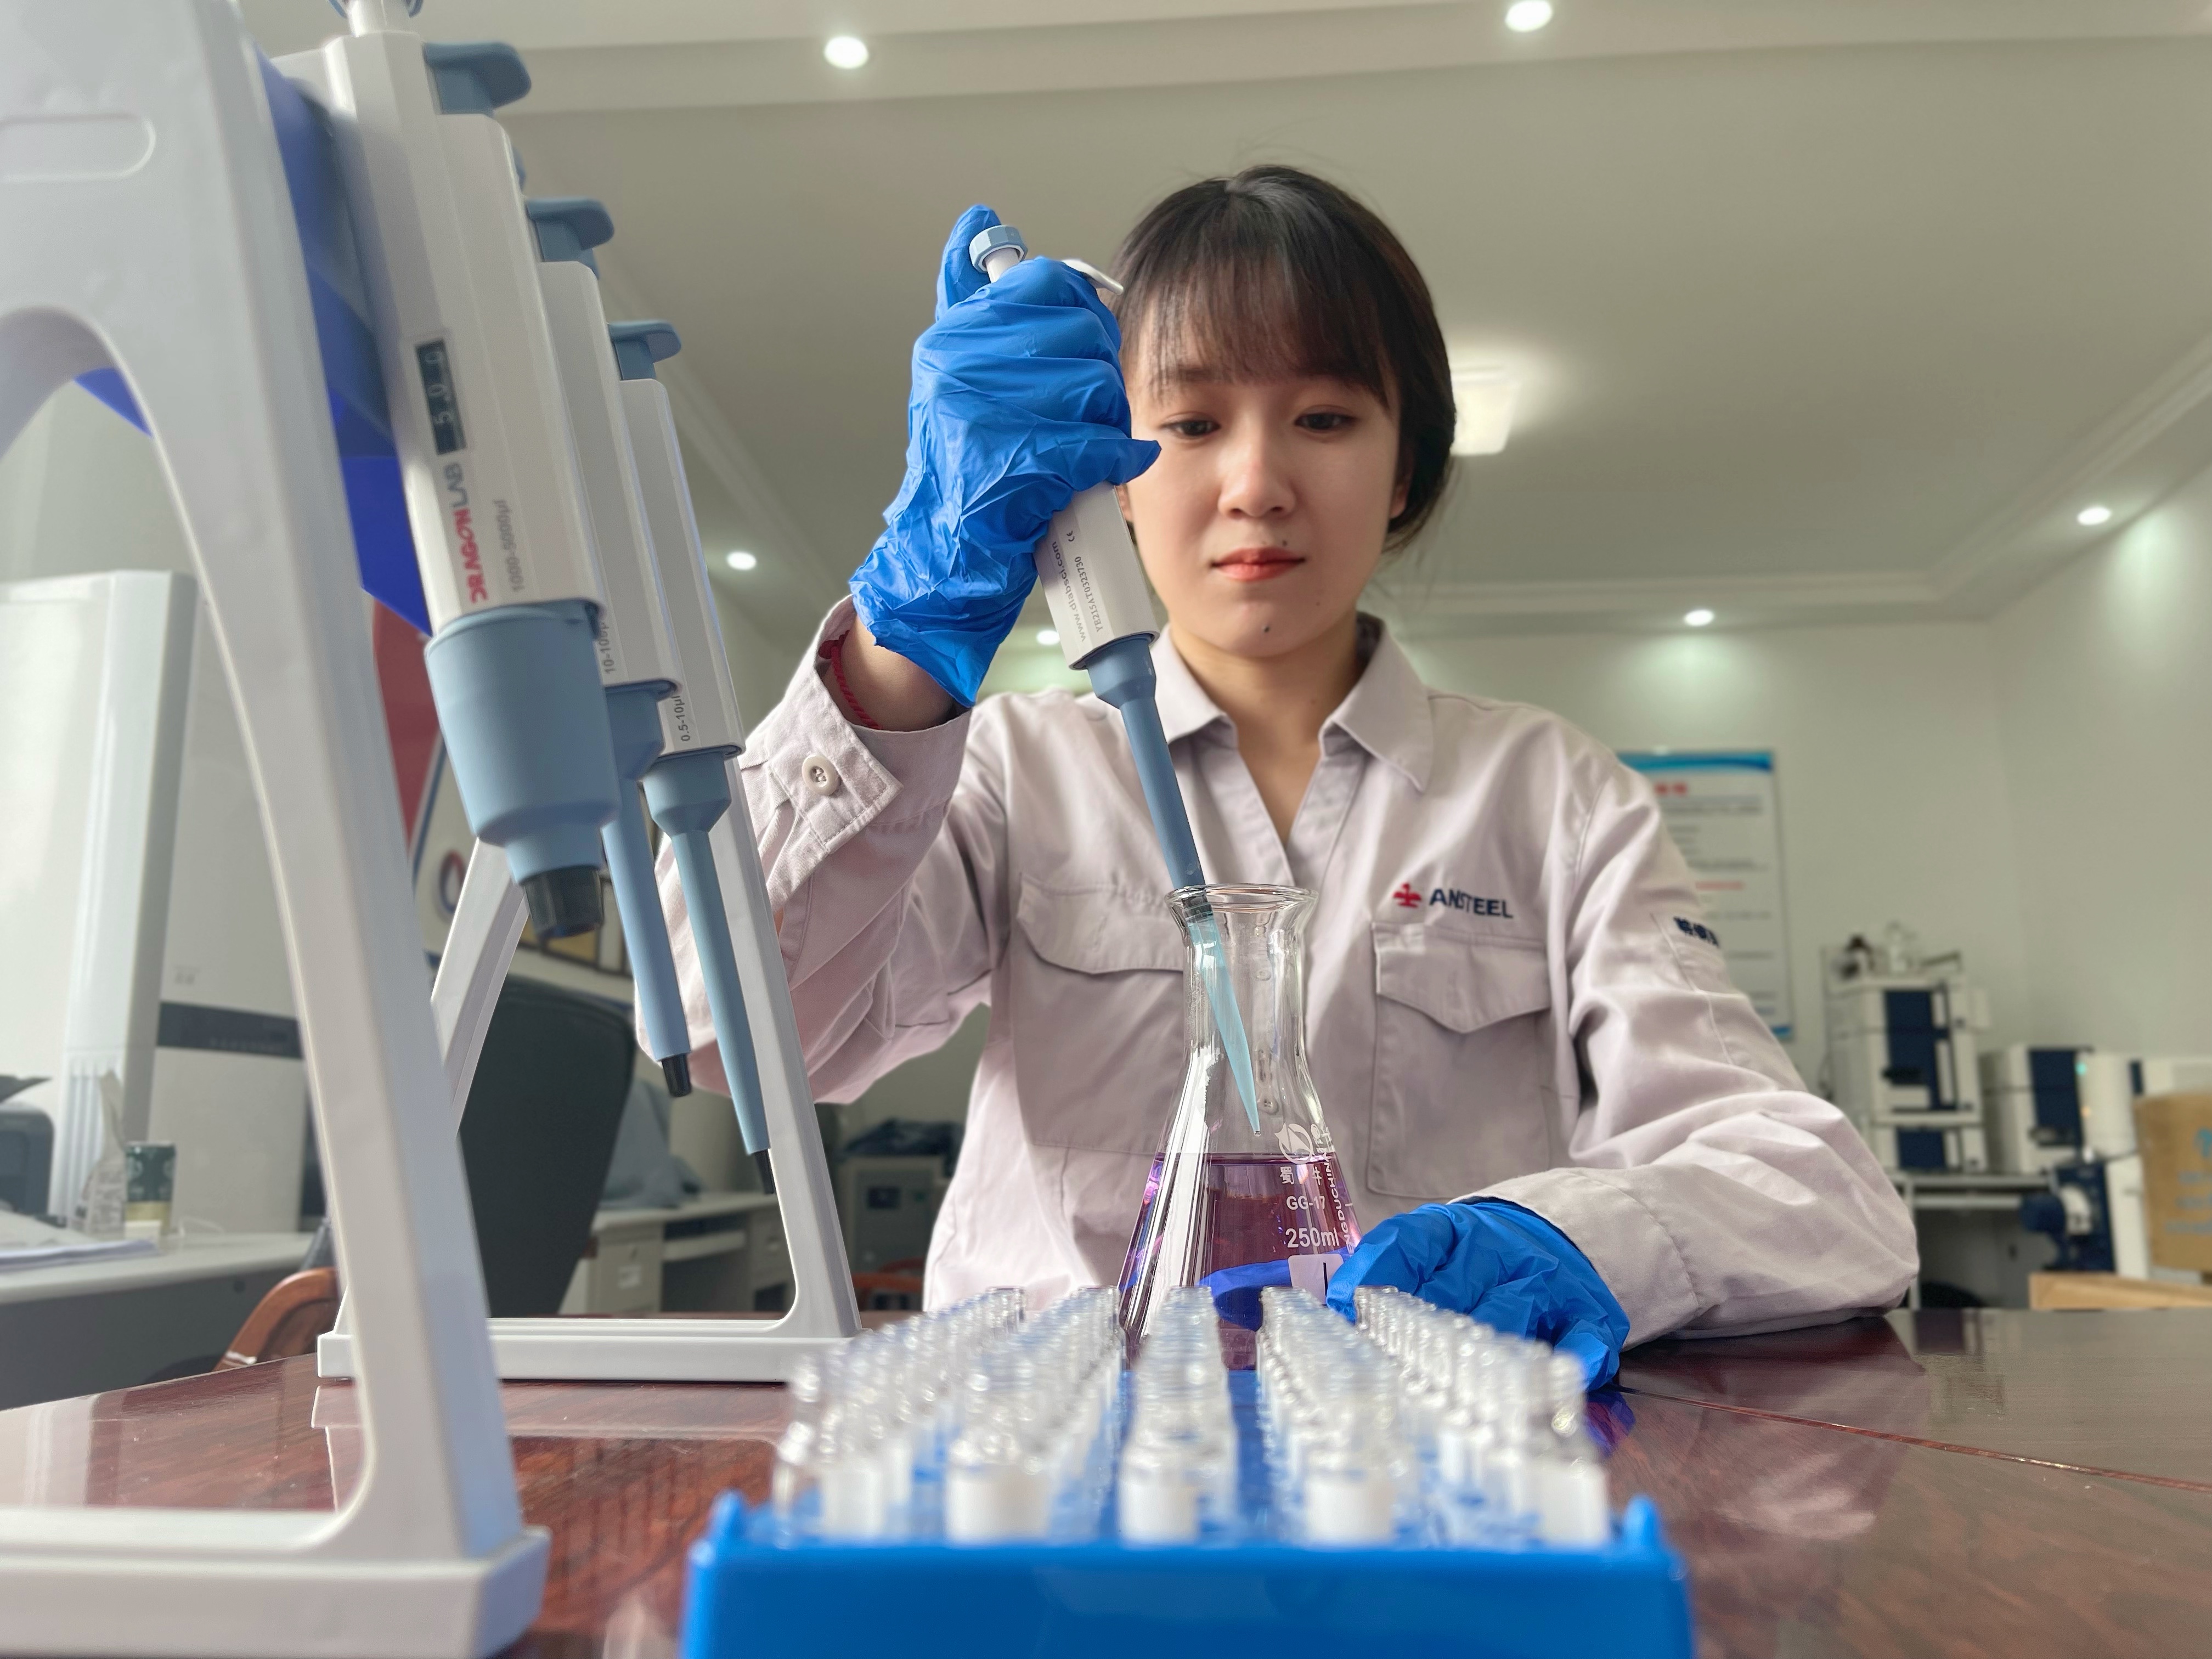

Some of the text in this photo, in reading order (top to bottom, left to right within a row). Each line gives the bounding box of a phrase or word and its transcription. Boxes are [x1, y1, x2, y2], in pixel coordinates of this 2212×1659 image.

[444, 462, 489, 604] DRAGONLAB
[1052, 541, 1086, 642] www.dlabsci.com
[1074, 556, 1103, 633] YB215AT0323730
[1429, 888, 1513, 919] ANSTEEL
[1286, 1195, 1325, 1210] GG-17
[1285, 1227, 1340, 1248] 250ml
